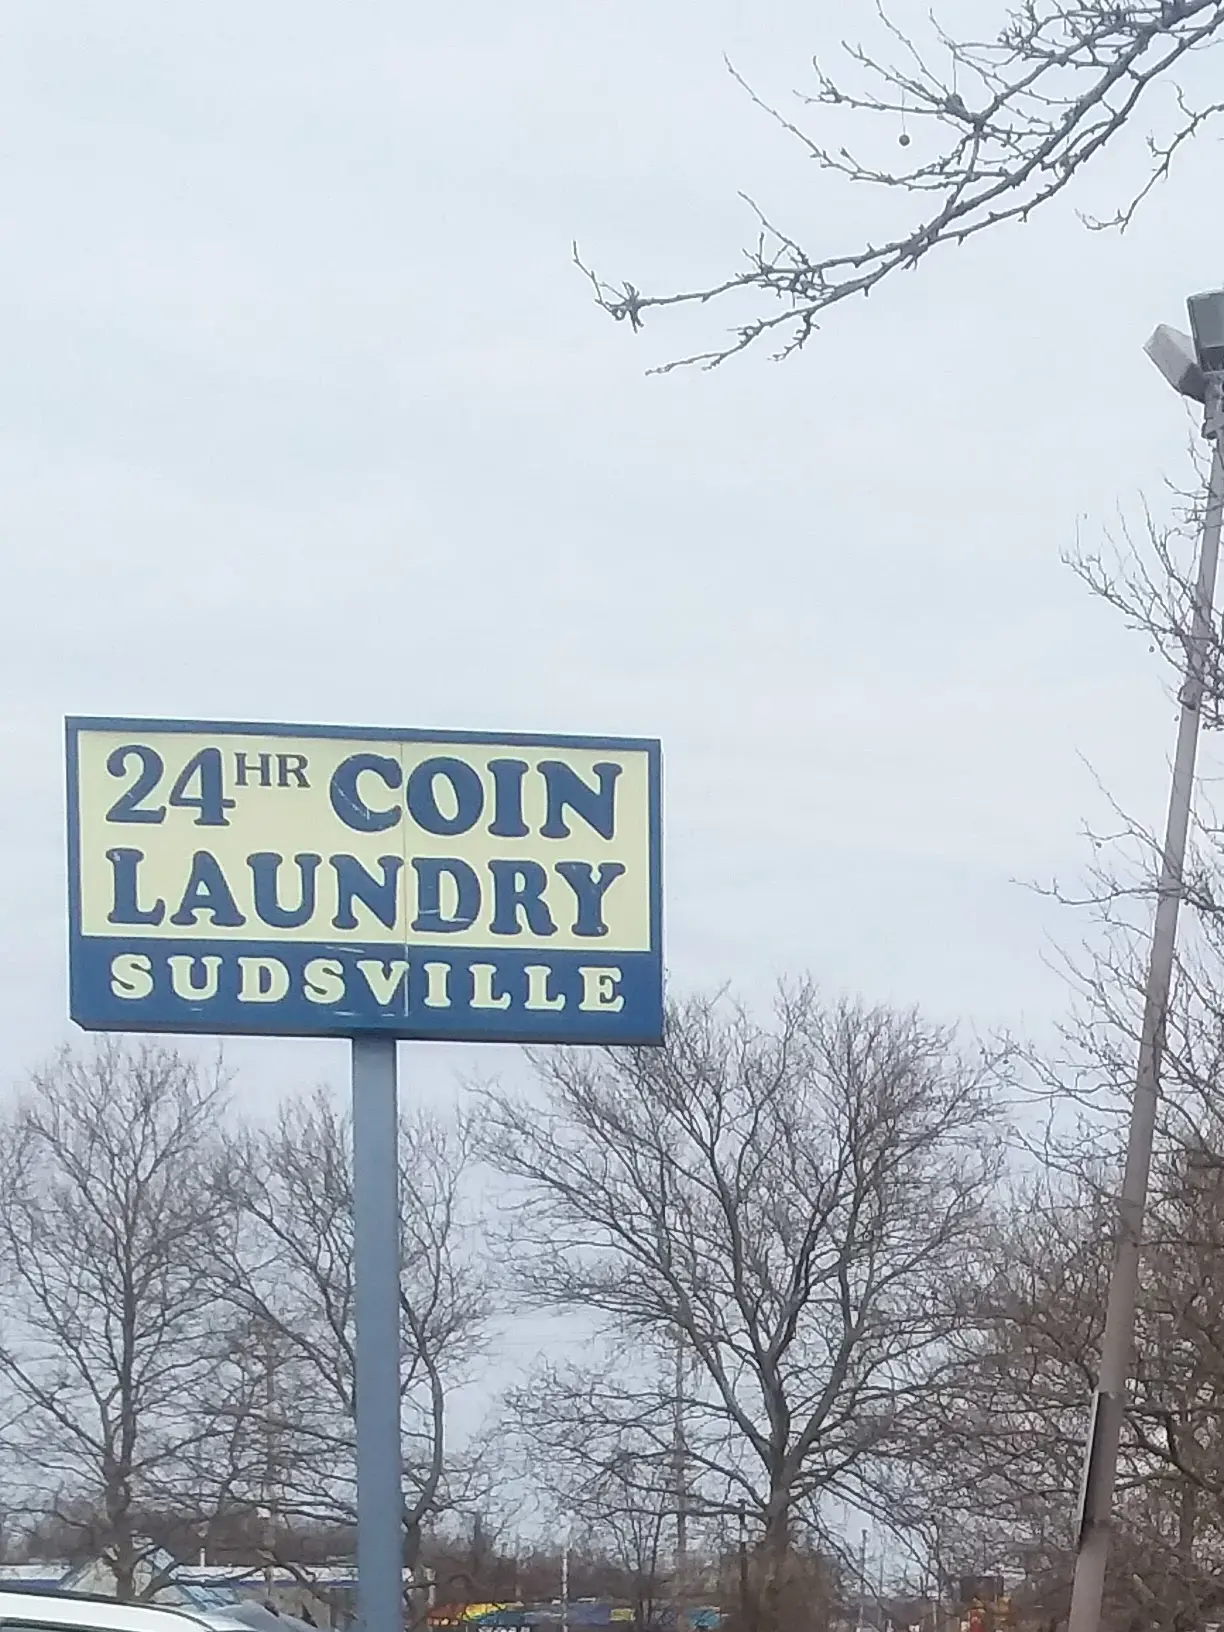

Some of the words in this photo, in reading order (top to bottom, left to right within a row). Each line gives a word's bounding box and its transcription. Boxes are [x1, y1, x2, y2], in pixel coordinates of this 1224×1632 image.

[329, 752, 624, 841] COIN
[105, 847, 626, 938] LAUNDRY
[109, 953, 626, 1013] SUDSVILLE
